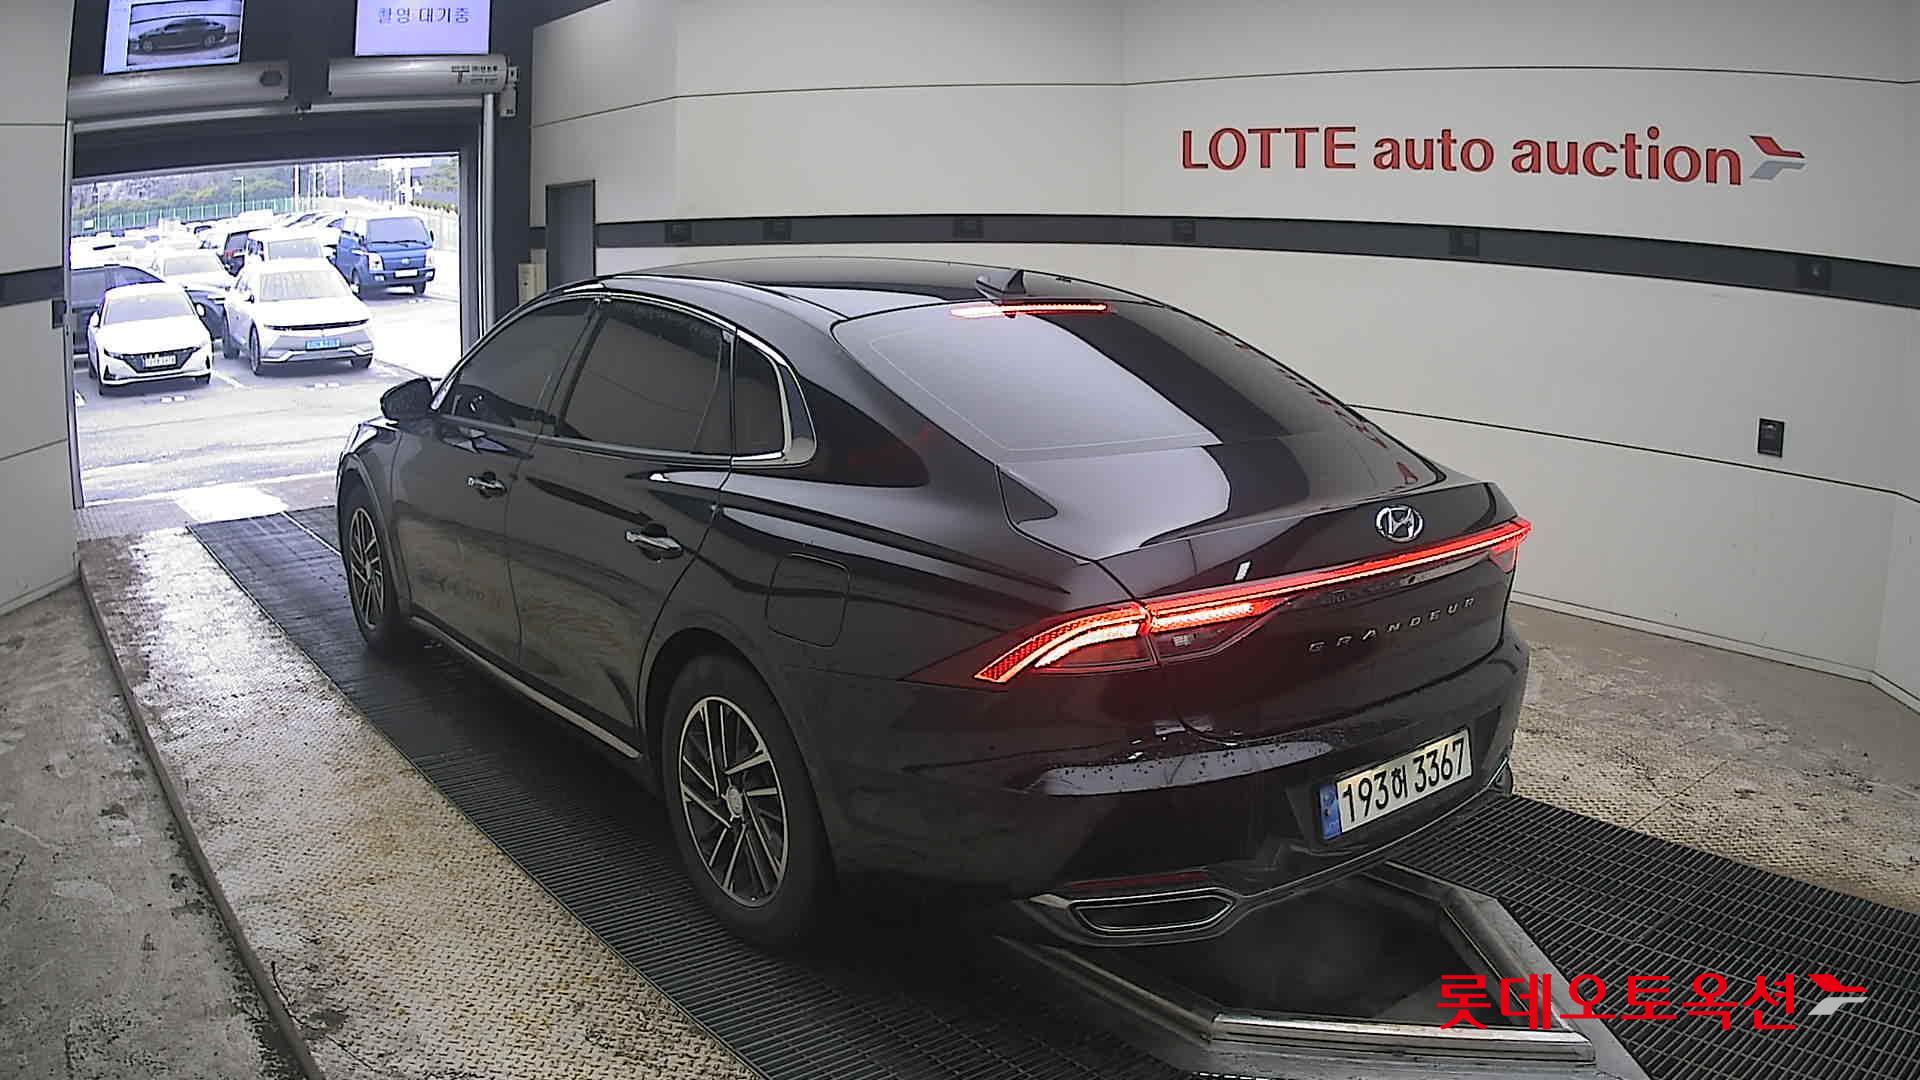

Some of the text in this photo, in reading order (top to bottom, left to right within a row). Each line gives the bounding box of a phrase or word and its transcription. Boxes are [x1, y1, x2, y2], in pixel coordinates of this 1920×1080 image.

[418, 7, 471, 24] 대기중
[1181, 126, 1742, 186] LOTTE auto auction
[1308, 597, 1475, 652] GRANDEUR
[1341, 737, 1465, 823] 193허 3367
